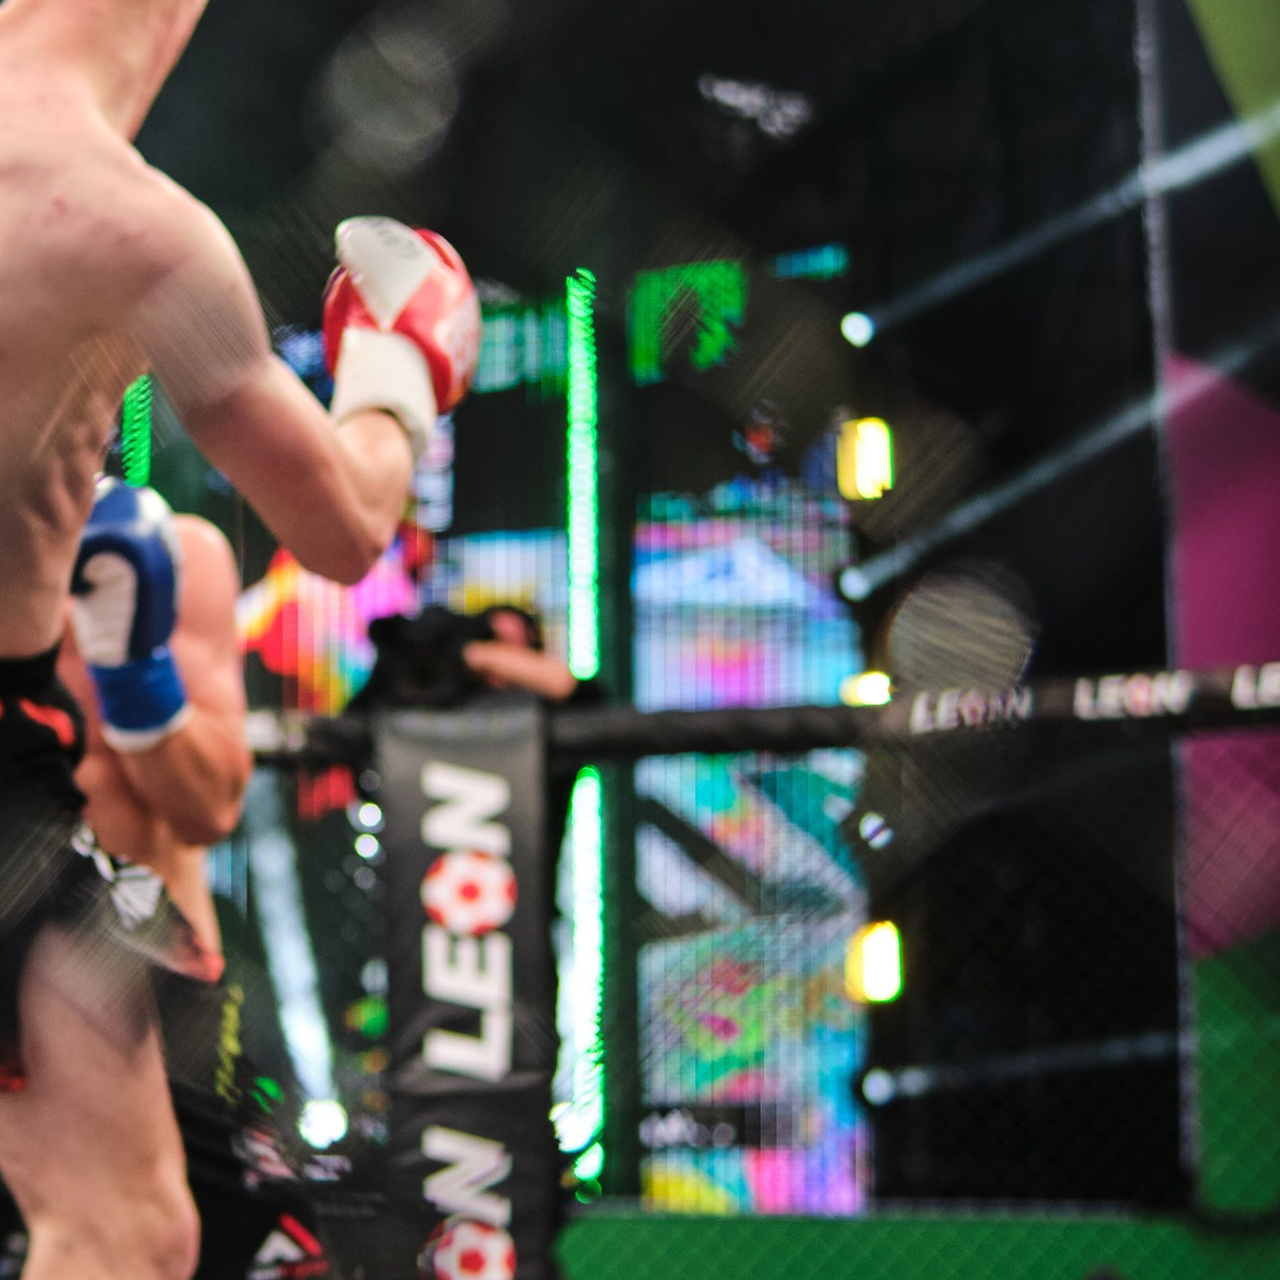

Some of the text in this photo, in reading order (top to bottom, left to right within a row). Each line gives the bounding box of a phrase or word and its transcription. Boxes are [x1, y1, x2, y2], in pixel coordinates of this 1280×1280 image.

[909, 685, 1033, 734] LEON
[1073, 668, 1195, 720] LEON
[421, 759, 519, 1084] LEON
